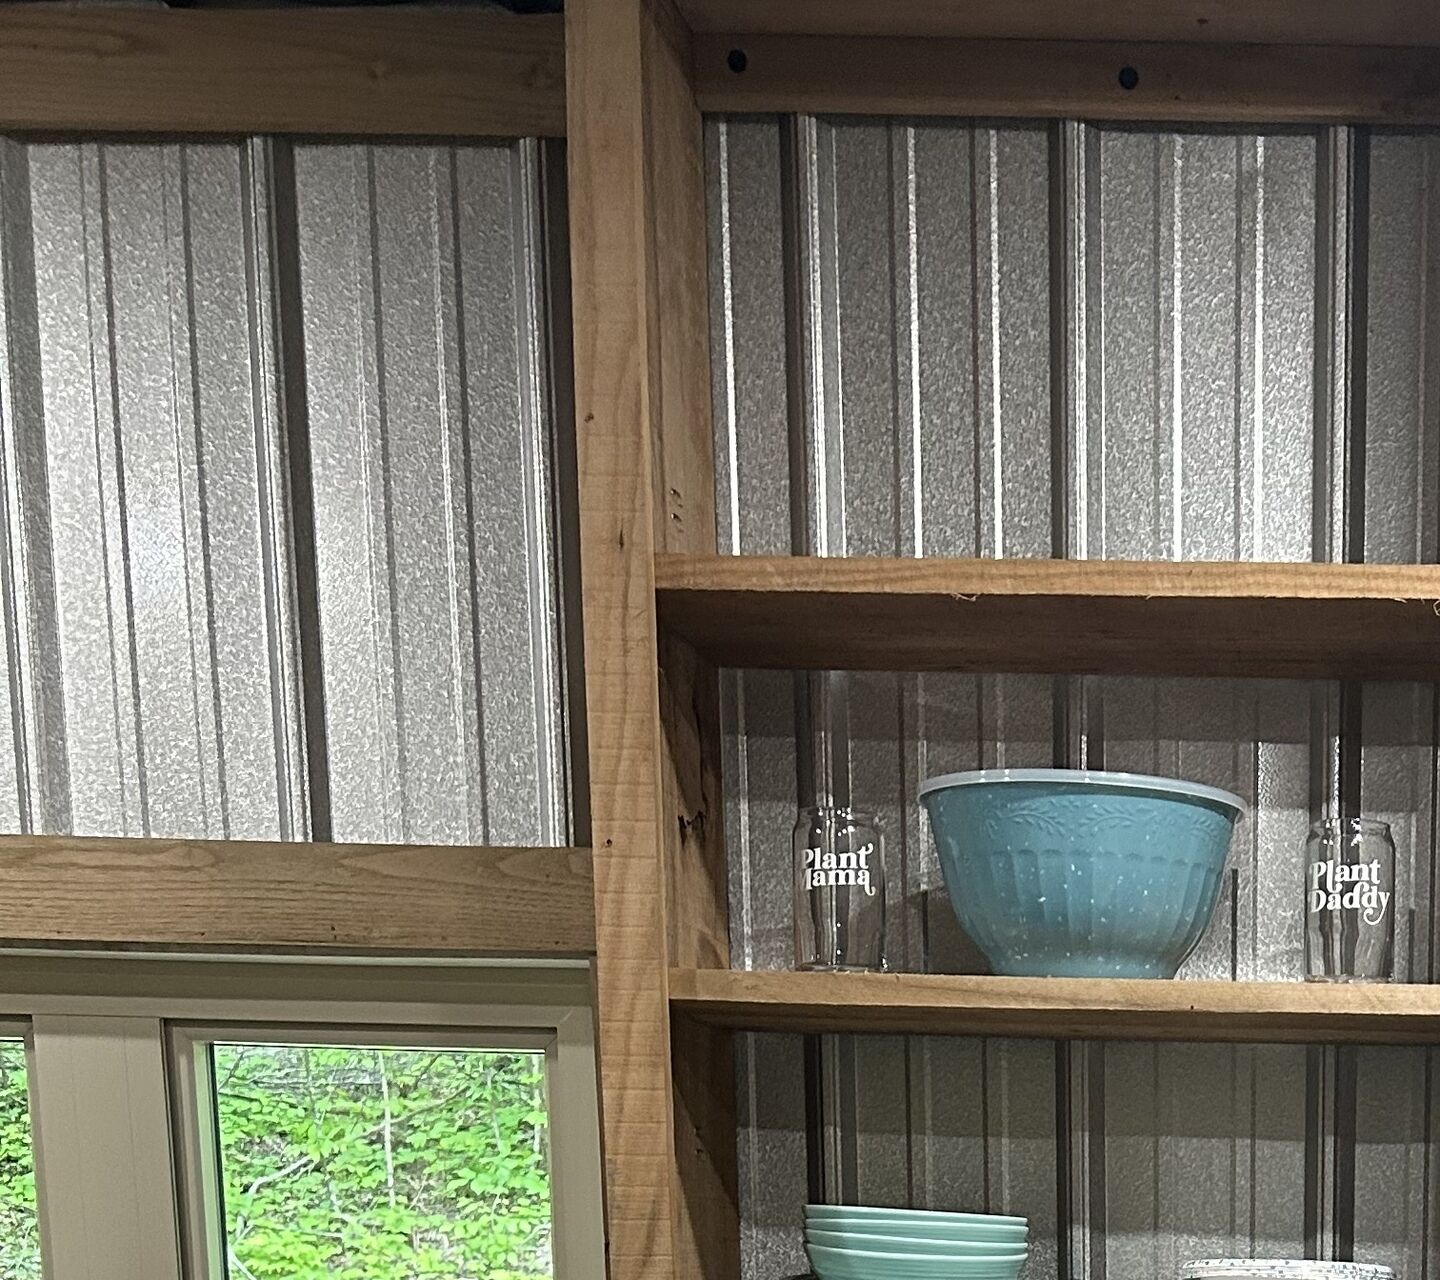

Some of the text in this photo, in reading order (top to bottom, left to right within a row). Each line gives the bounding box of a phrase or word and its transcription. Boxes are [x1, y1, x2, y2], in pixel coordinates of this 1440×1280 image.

[801, 842, 874, 870] Plant
[1310, 859, 1381, 894] Plant
[1310, 881, 1391, 926] Daddy
